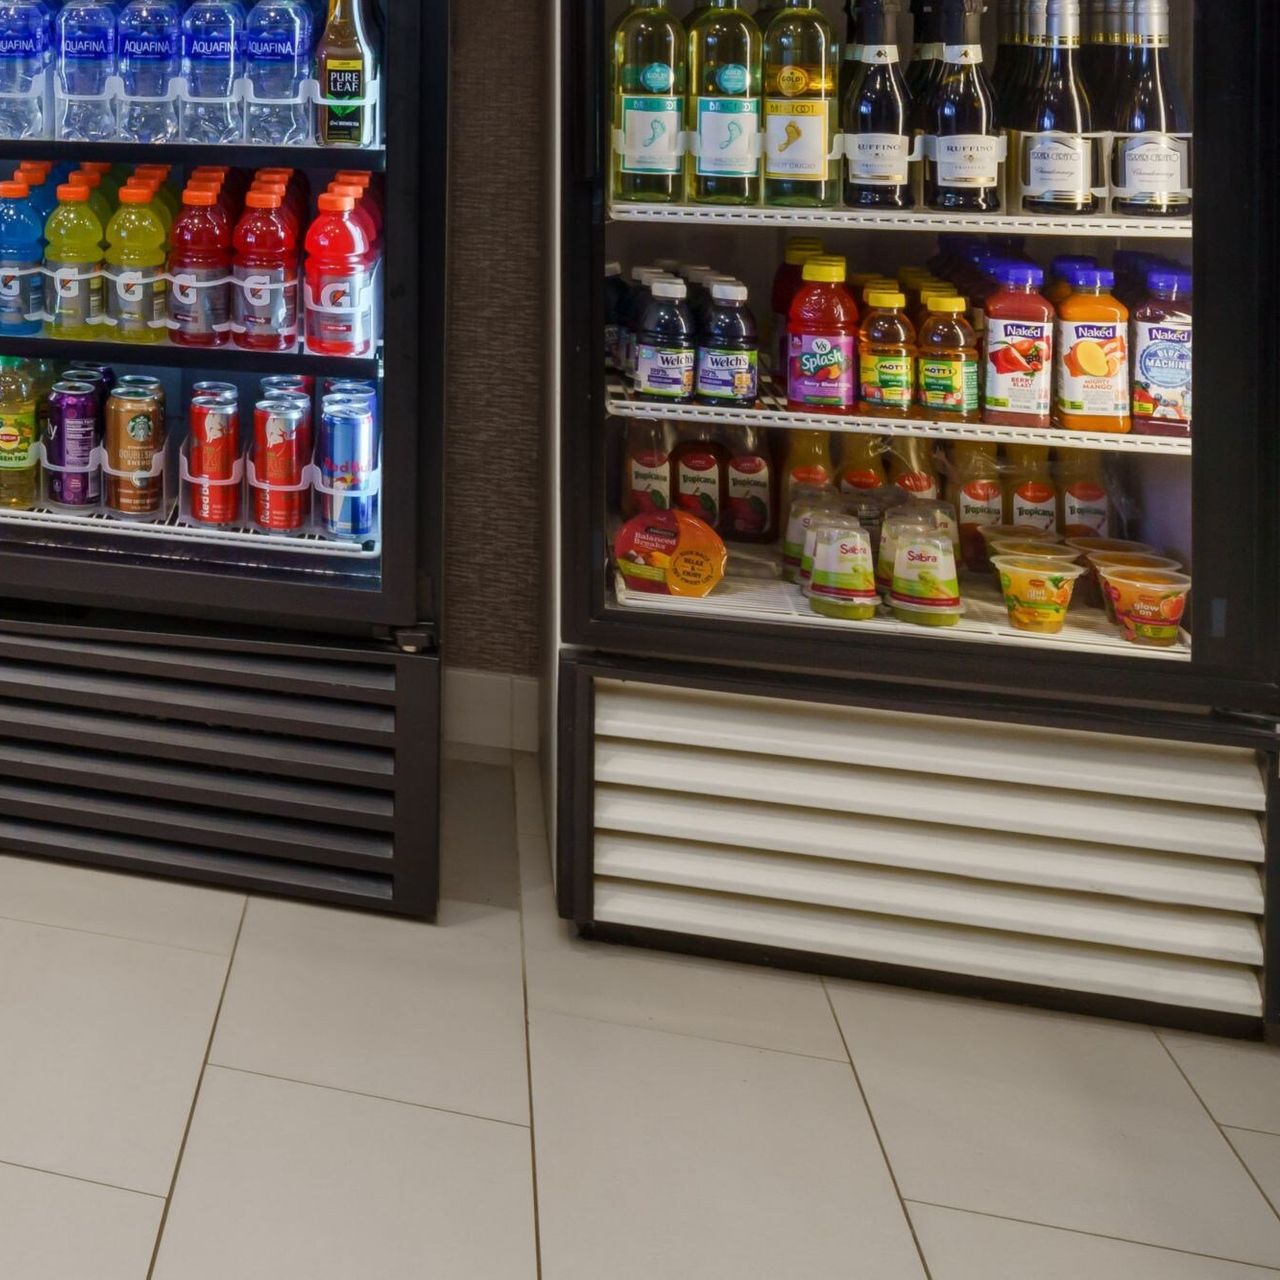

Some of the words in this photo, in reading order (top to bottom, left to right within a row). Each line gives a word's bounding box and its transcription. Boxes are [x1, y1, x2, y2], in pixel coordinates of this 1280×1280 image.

[61, 39, 106, 52] AQUAFINA
[124, 40, 170, 55] AQUAFINA
[192, 40, 238, 55] AQUAFINA
[248, 41, 293, 55] AQUAFINA
[330, 71, 359, 83] PURE
[330, 81, 359, 92] LEAF
[243, 275, 270, 306] G
[1006, 324, 1041, 338] Naked
[1078, 325, 1113, 338] Naked
[1152, 328, 1189, 341] Naked
[814, 340, 829, 352] V8
[709, 356, 748, 367] Welch's
[801, 351, 844, 372] Splash
[633, 471, 668, 482] Tropicana
[682, 474, 716, 486] Tropicana
[731, 476, 767, 488] Tropicana
[963, 504, 1001, 516] Tropicana
[1016, 506, 1054, 518] Tropicana
[634, 537, 667, 550] Breaks
[635, 531, 676, 546] Balanced
[907, 549, 937, 563] Sabra
